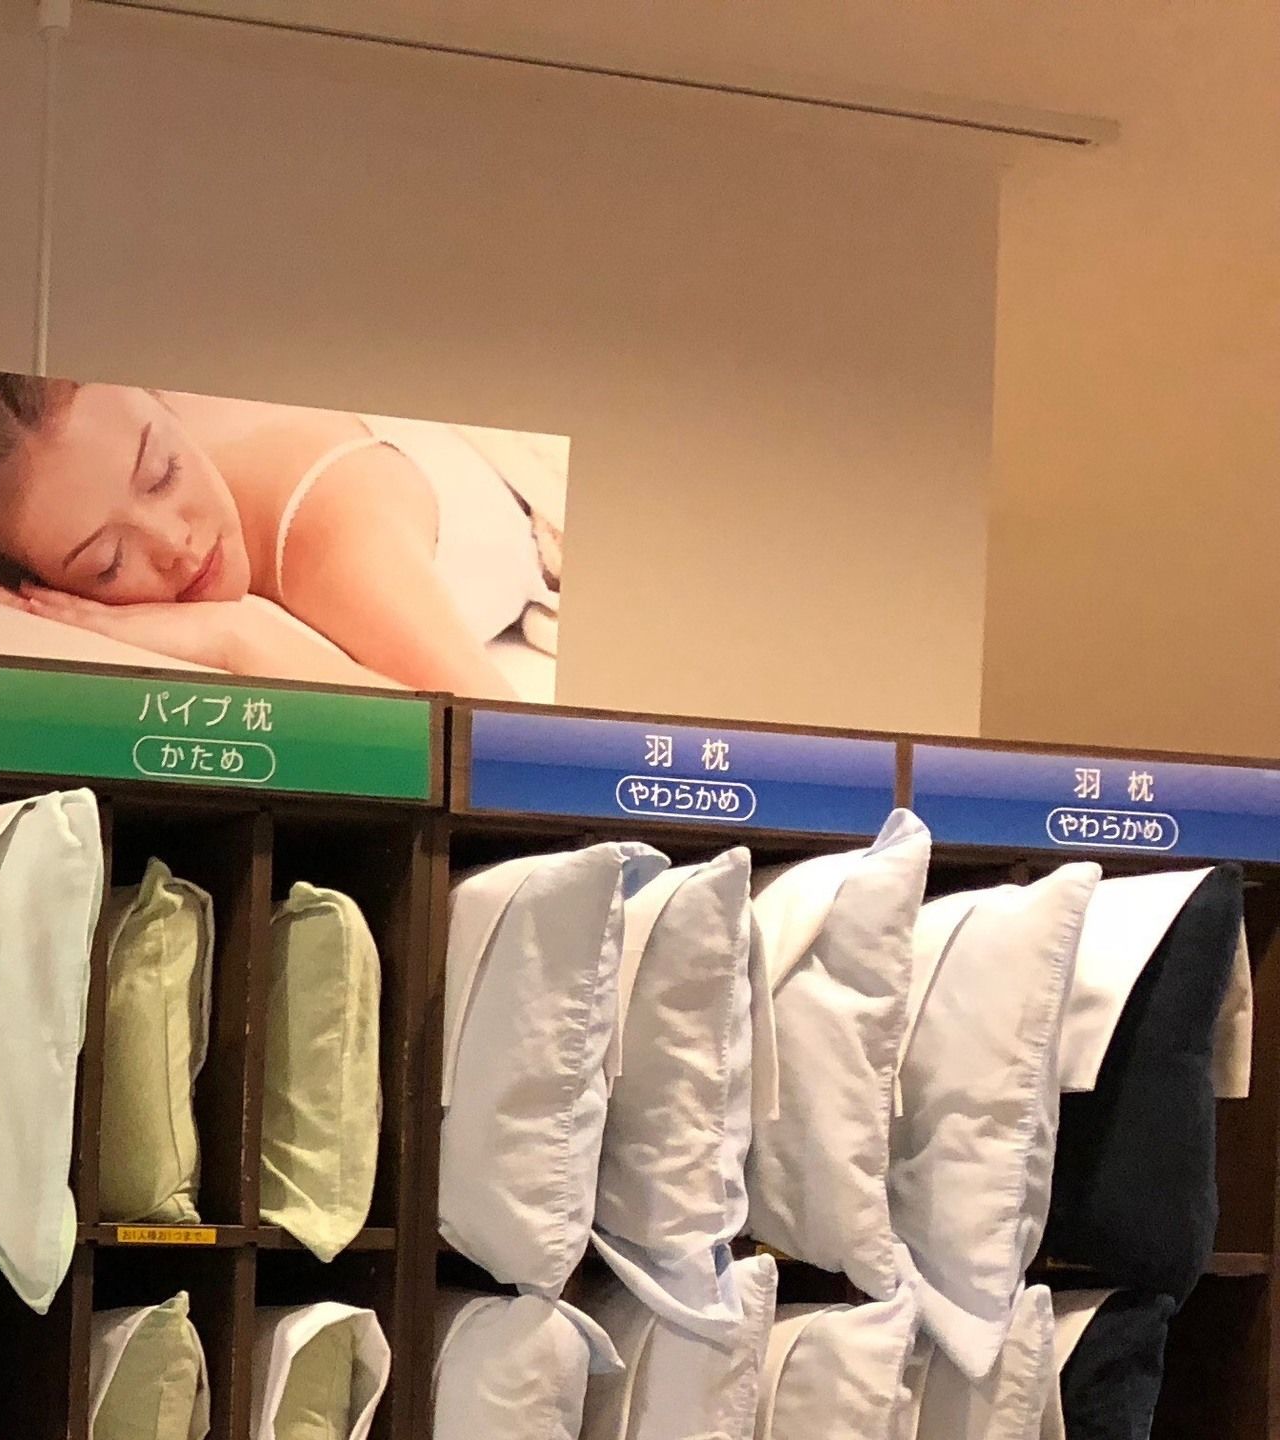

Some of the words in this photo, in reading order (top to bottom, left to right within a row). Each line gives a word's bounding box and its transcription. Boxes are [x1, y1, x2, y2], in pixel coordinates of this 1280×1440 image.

[160, 743, 244, 773] かため
[628, 781, 740, 813] やわらかめ
[1058, 814, 1163, 842] やわらかめ
